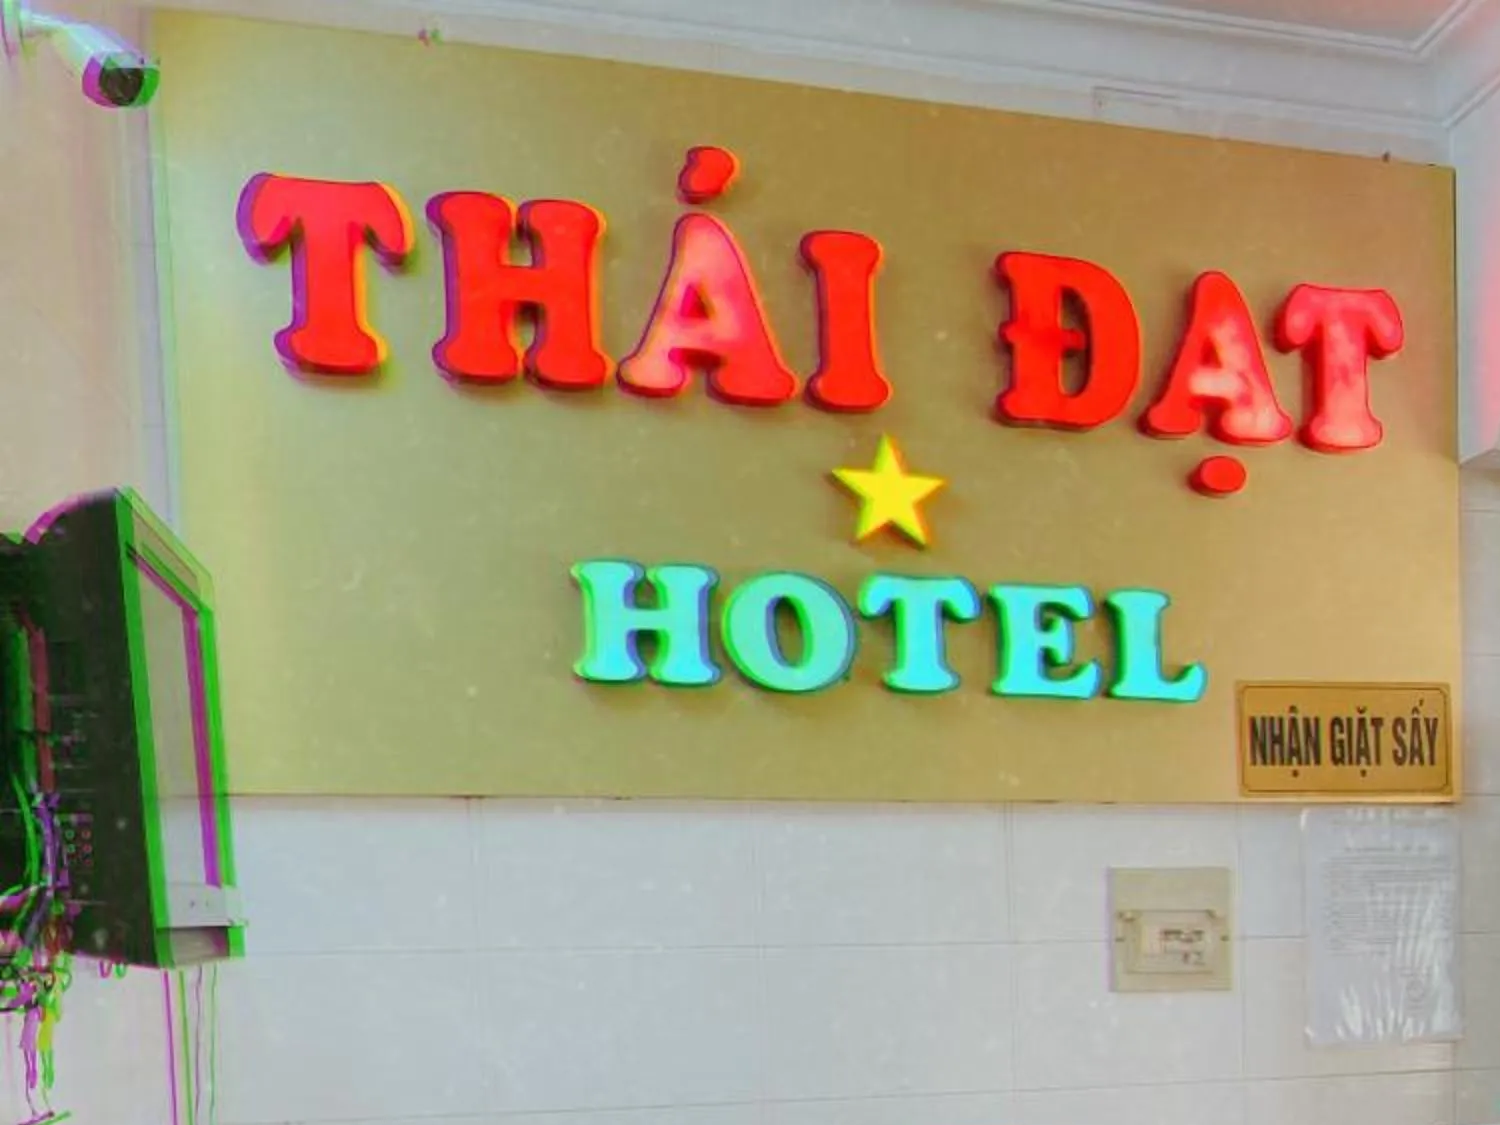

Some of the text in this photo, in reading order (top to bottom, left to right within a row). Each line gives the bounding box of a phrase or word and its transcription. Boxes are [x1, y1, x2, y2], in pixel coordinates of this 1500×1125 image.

[994, 250, 1404, 495] ĐẠT
[572, 557, 1207, 704] HOTEL
[1249, 698, 1439, 778] NHẬN GIẶT SẤY
